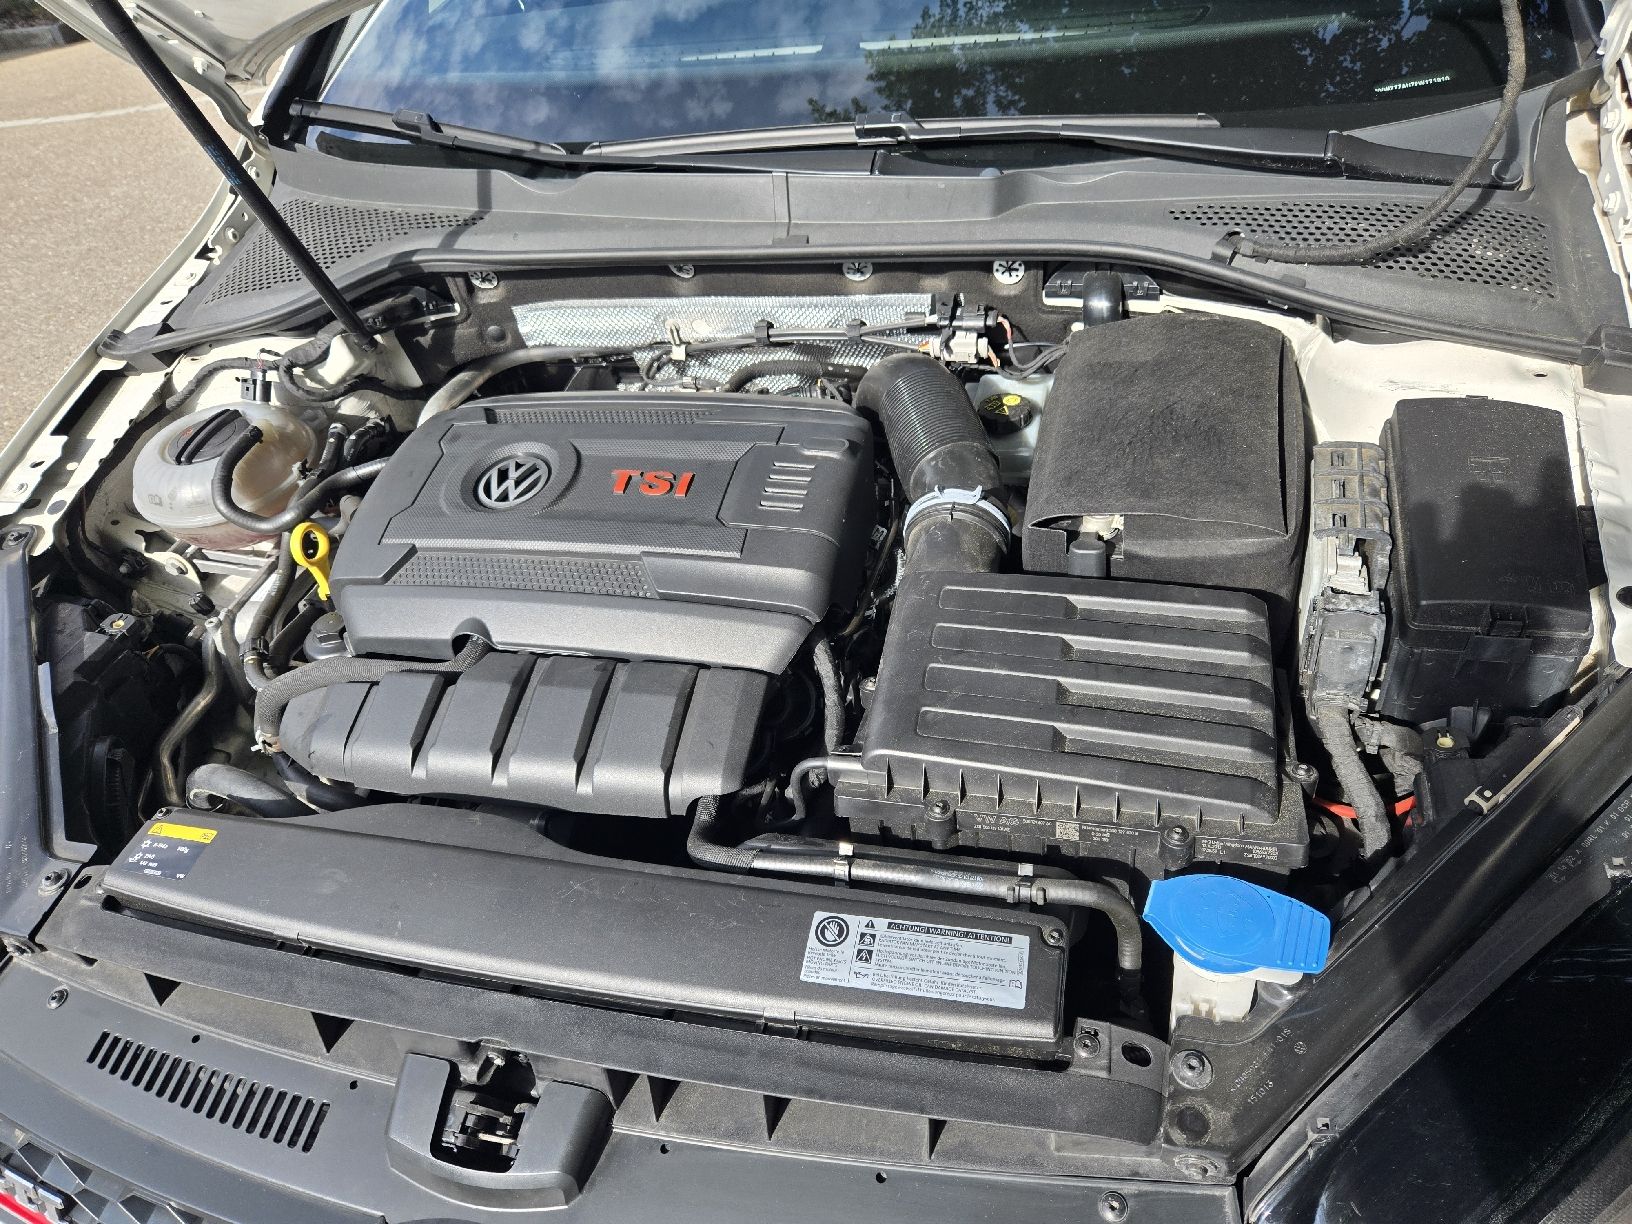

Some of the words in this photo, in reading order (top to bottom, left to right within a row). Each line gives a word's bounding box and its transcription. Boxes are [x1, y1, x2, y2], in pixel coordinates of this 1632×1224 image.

[612, 469, 695, 498] TSI
[890, 922, 927, 934] ACHTUNG!
[929, 927, 966, 938] WARNING!
[968, 932, 1010, 944] ATTENTION!
